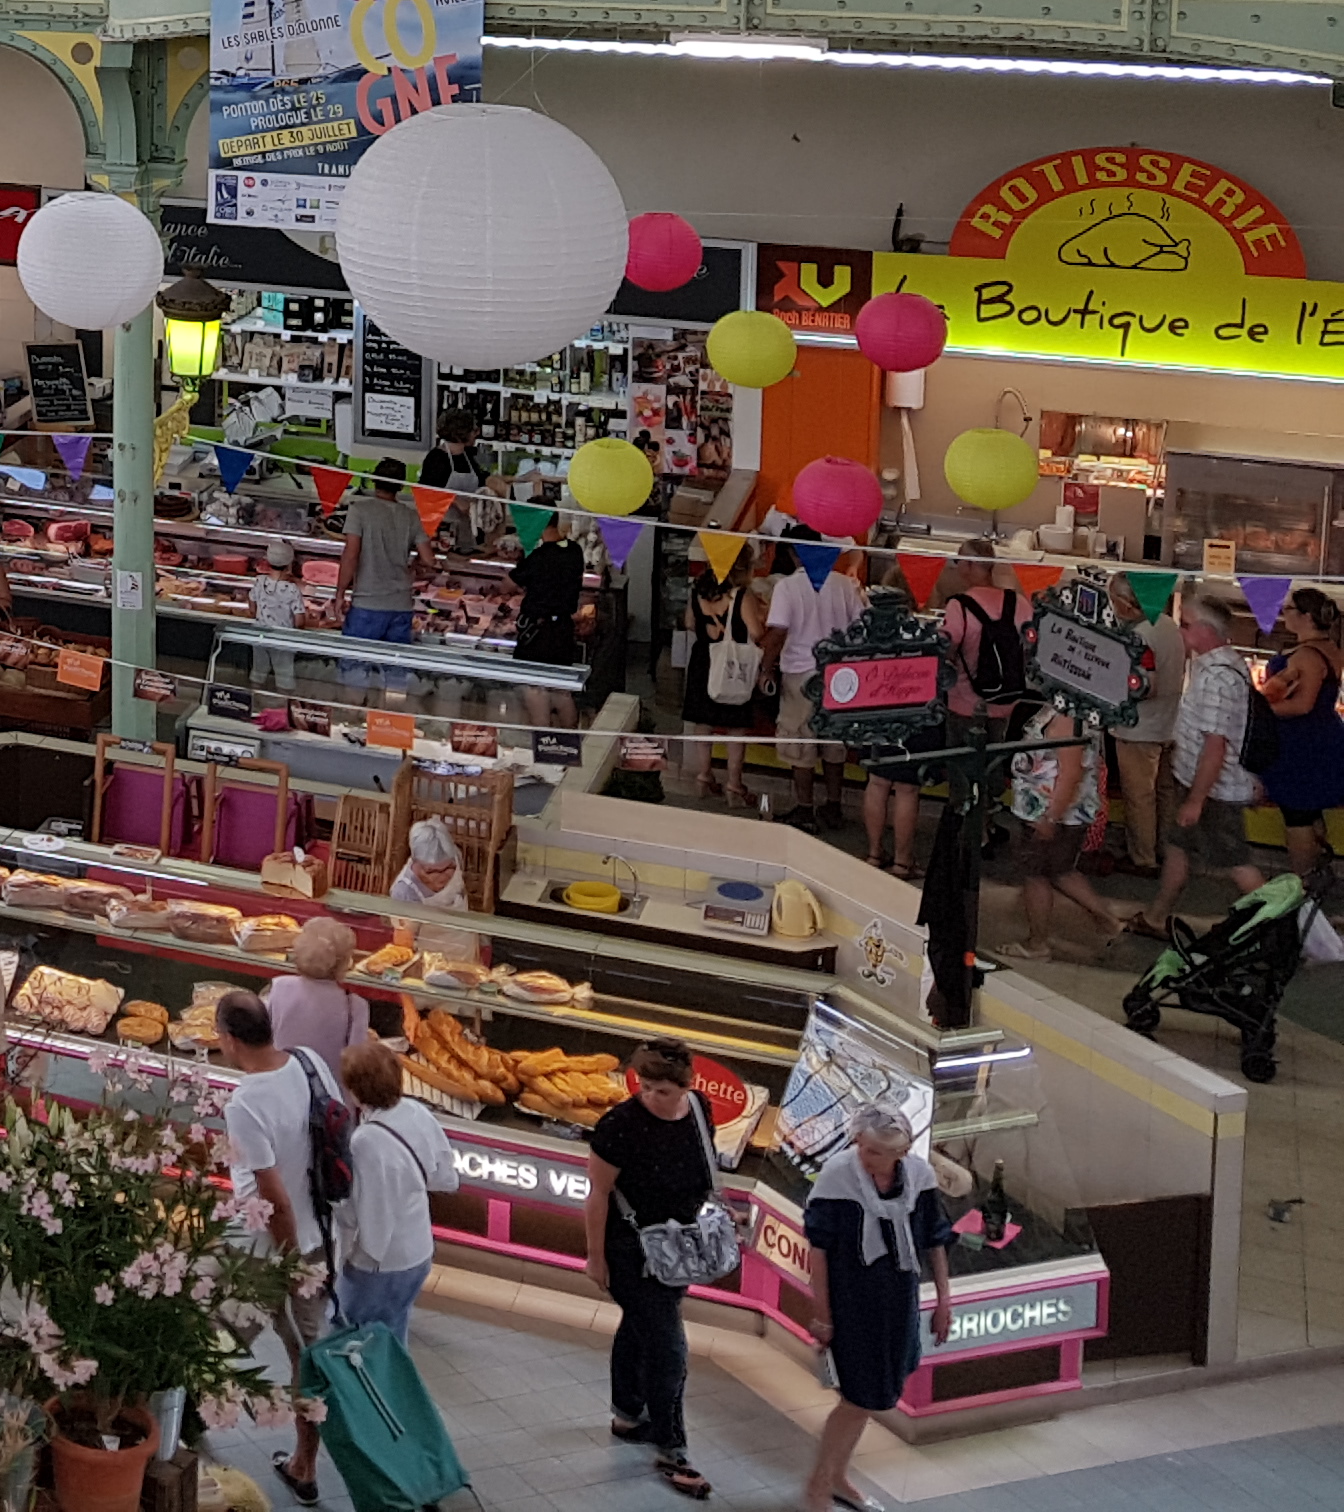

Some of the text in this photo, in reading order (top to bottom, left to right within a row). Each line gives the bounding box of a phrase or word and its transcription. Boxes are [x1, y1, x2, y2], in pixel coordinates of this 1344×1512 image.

[221, 33, 241, 50] LES
[243, 26, 284, 45] SABLES
[294, 93, 308, 108] LE
[311, 91, 326, 104] 25
[250, 104, 343, 131] PROLOGUE LE 29
[270, 133, 284, 147] LE
[288, 130, 303, 144] 30
[307, 122, 352, 141] JUILLET
[969, 152, 1286, 259] ROTISSERIE
[164, 222, 209, 239] ance
[976, 280, 1190, 357] Boutique
[1214, 297, 1269, 342] de
[451, 1150, 538, 1190] ACHES
[763, 1224, 812, 1275] CON
[948, 1298, 1073, 1341] BRIOCHES
